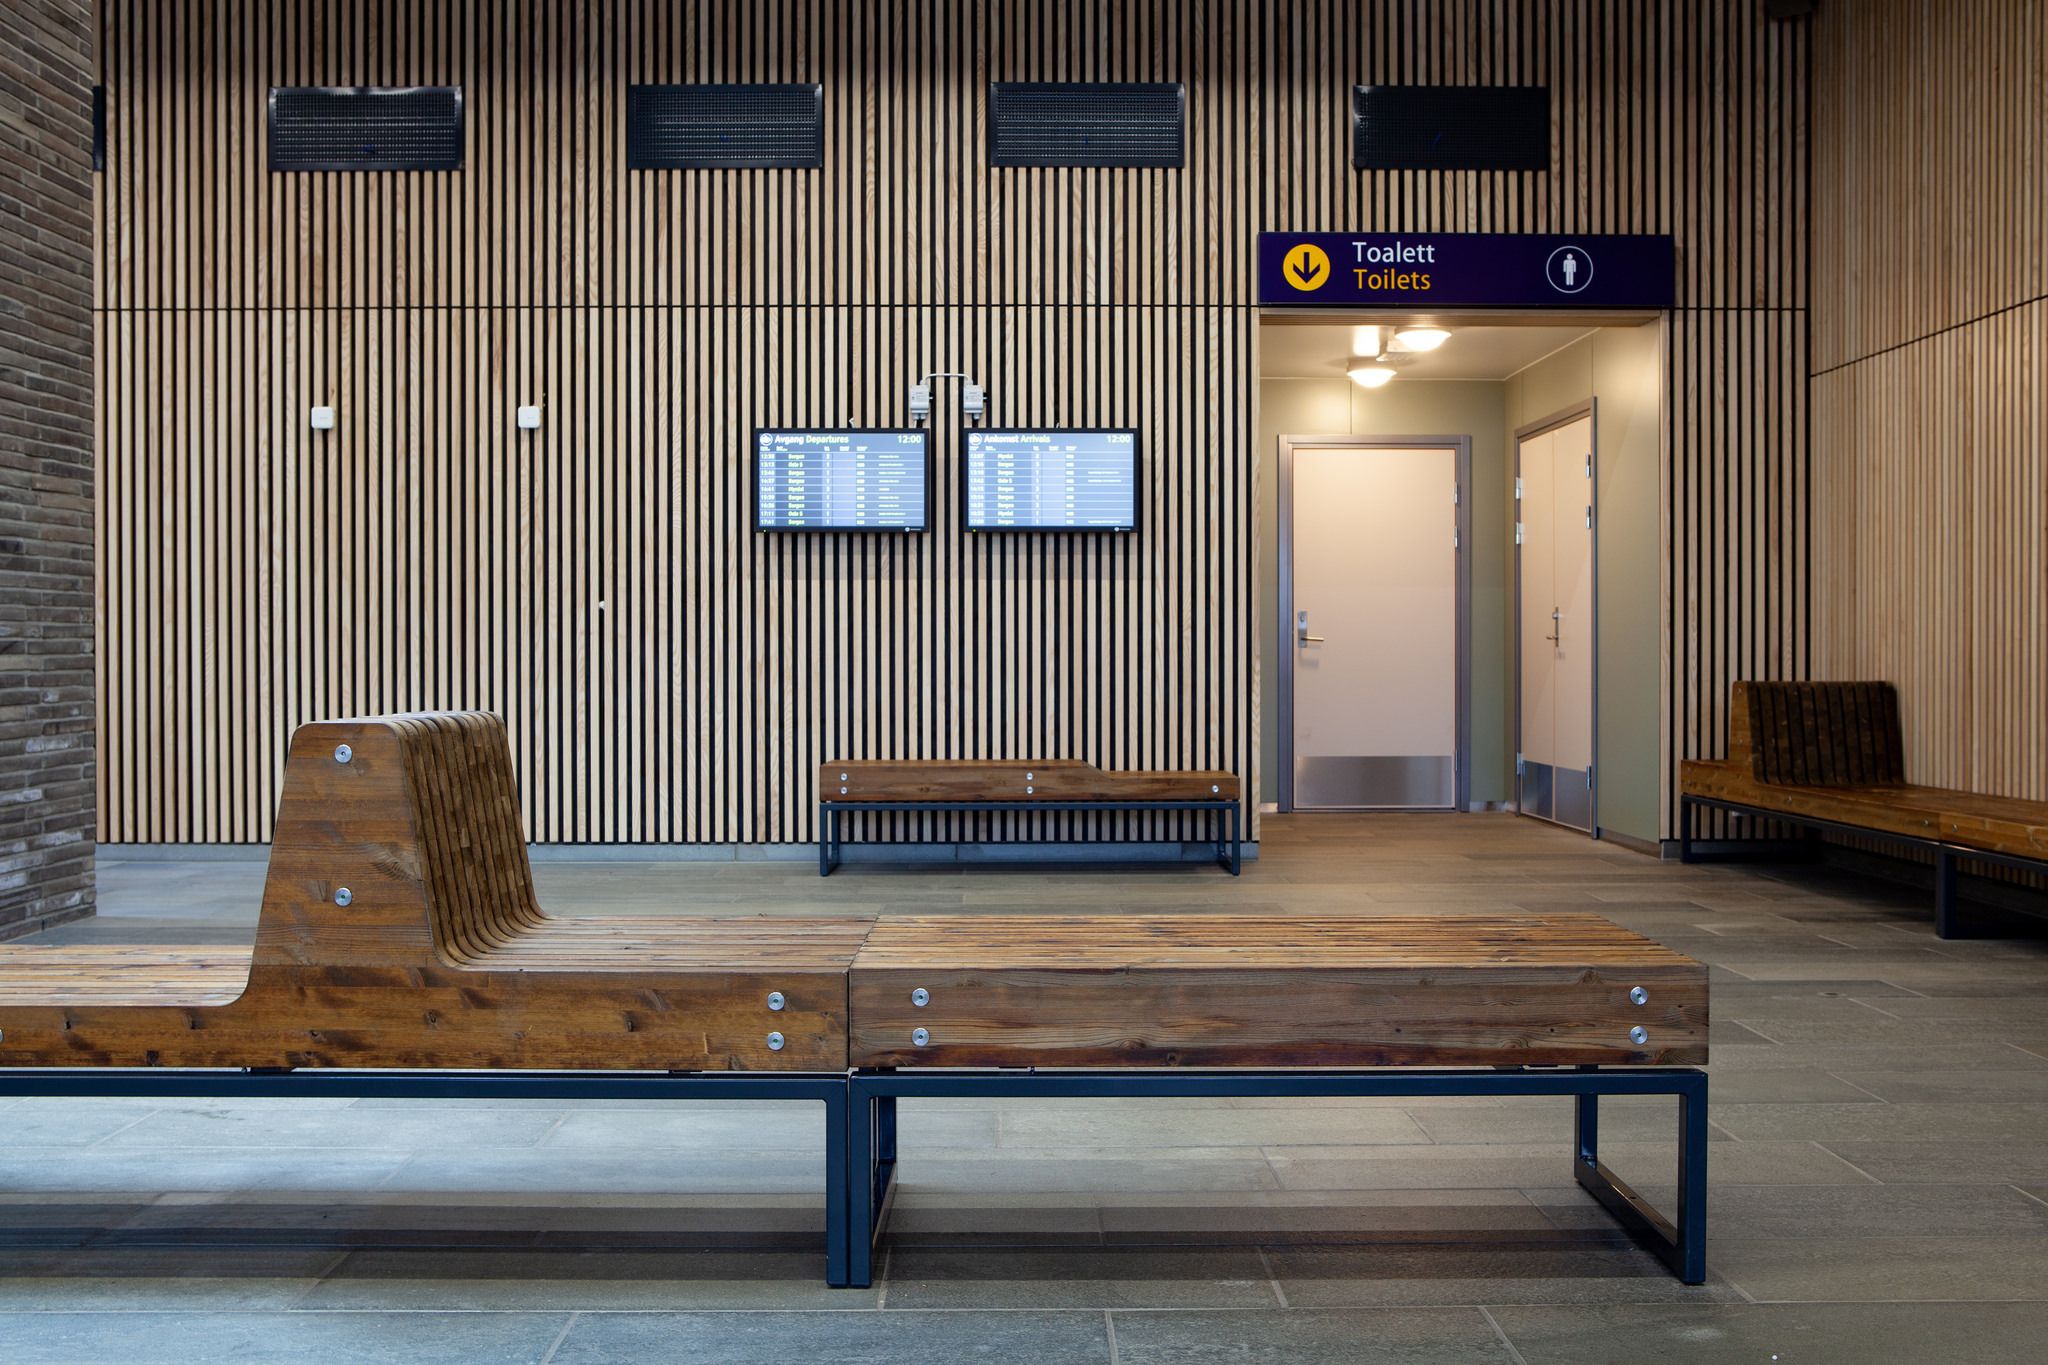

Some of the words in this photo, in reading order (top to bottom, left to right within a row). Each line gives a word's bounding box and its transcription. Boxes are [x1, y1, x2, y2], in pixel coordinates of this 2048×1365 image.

[1352, 241, 1435, 263] Toalett
[1353, 268, 1431, 290] Toilets
[774, 434, 804, 446] Avgang
[805, 434, 849, 446] Departures
[897, 434, 922, 444] 12:00
[984, 434, 1019, 444] Ankomst
[1020, 434, 1051, 444] Arrivals
[1106, 434, 1131, 444] 12:00
